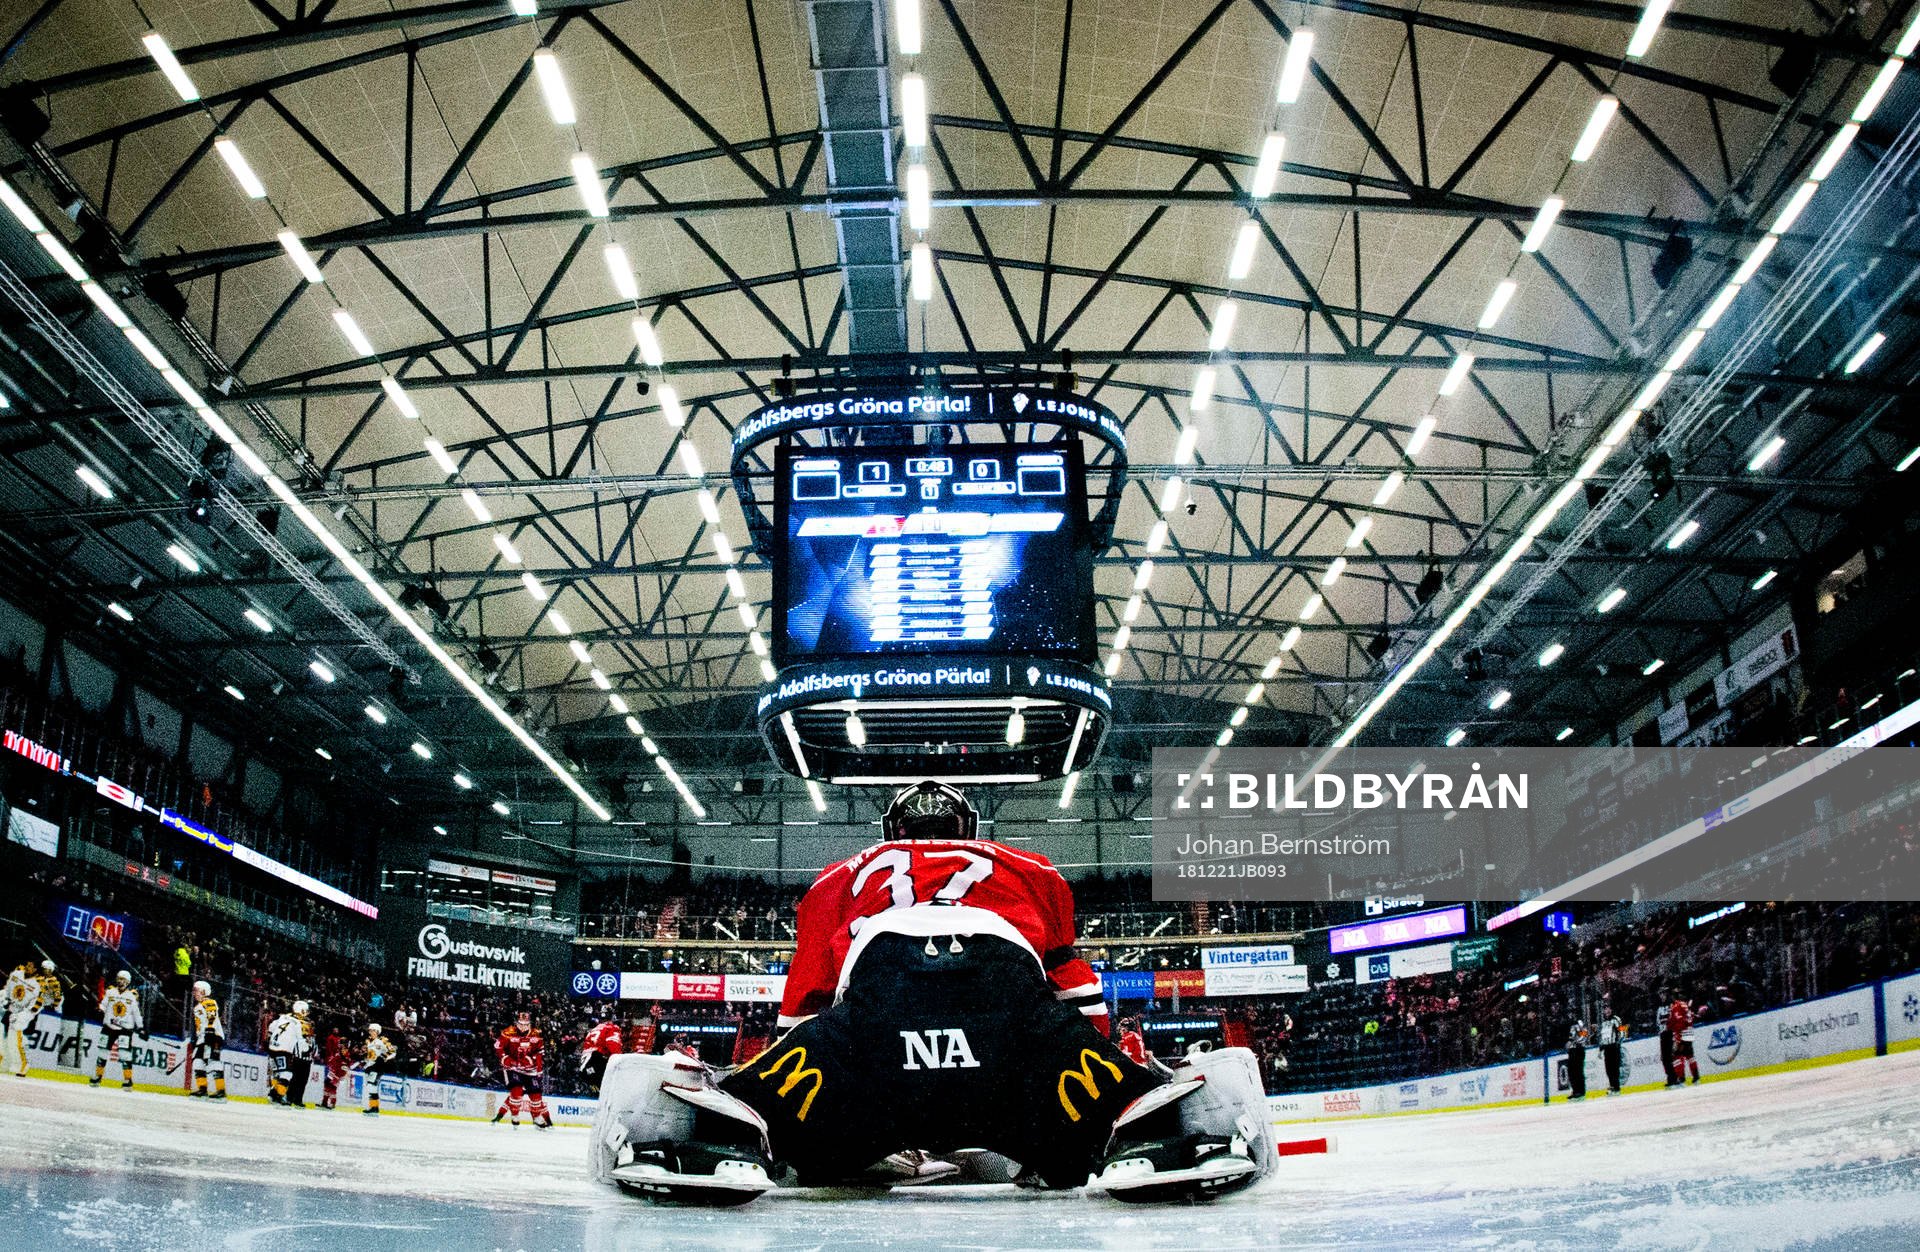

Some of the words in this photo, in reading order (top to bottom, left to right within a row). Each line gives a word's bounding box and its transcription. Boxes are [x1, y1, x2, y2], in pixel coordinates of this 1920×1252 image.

[739, 402, 834, 443] Adolfsbergs
[839, 397, 903, 414] Gröna
[908, 396, 971, 413] Pärla!
[1036, 399, 1097, 422] LEJONS
[871, 465, 880, 479] 1
[778, 673, 870, 699] Adolfsbergs
[874, 668, 931, 685] Gröna
[935, 666, 990, 684] Pärla!
[1046, 674, 1092, 694] LEJONS
[852, 849, 994, 908] 37
[63, 905, 124, 951] ELON
[418, 924, 525, 965] Gustavsvik
[1342, 929, 1368, 948] NA
[1383, 923, 1410, 942] NA
[1424, 915, 1452, 934] NA
[407, 957, 532, 990] FAMILJELÄKTARE
[1208, 949, 1288, 965] Vintergatan
[900, 1028, 981, 1070] NA
